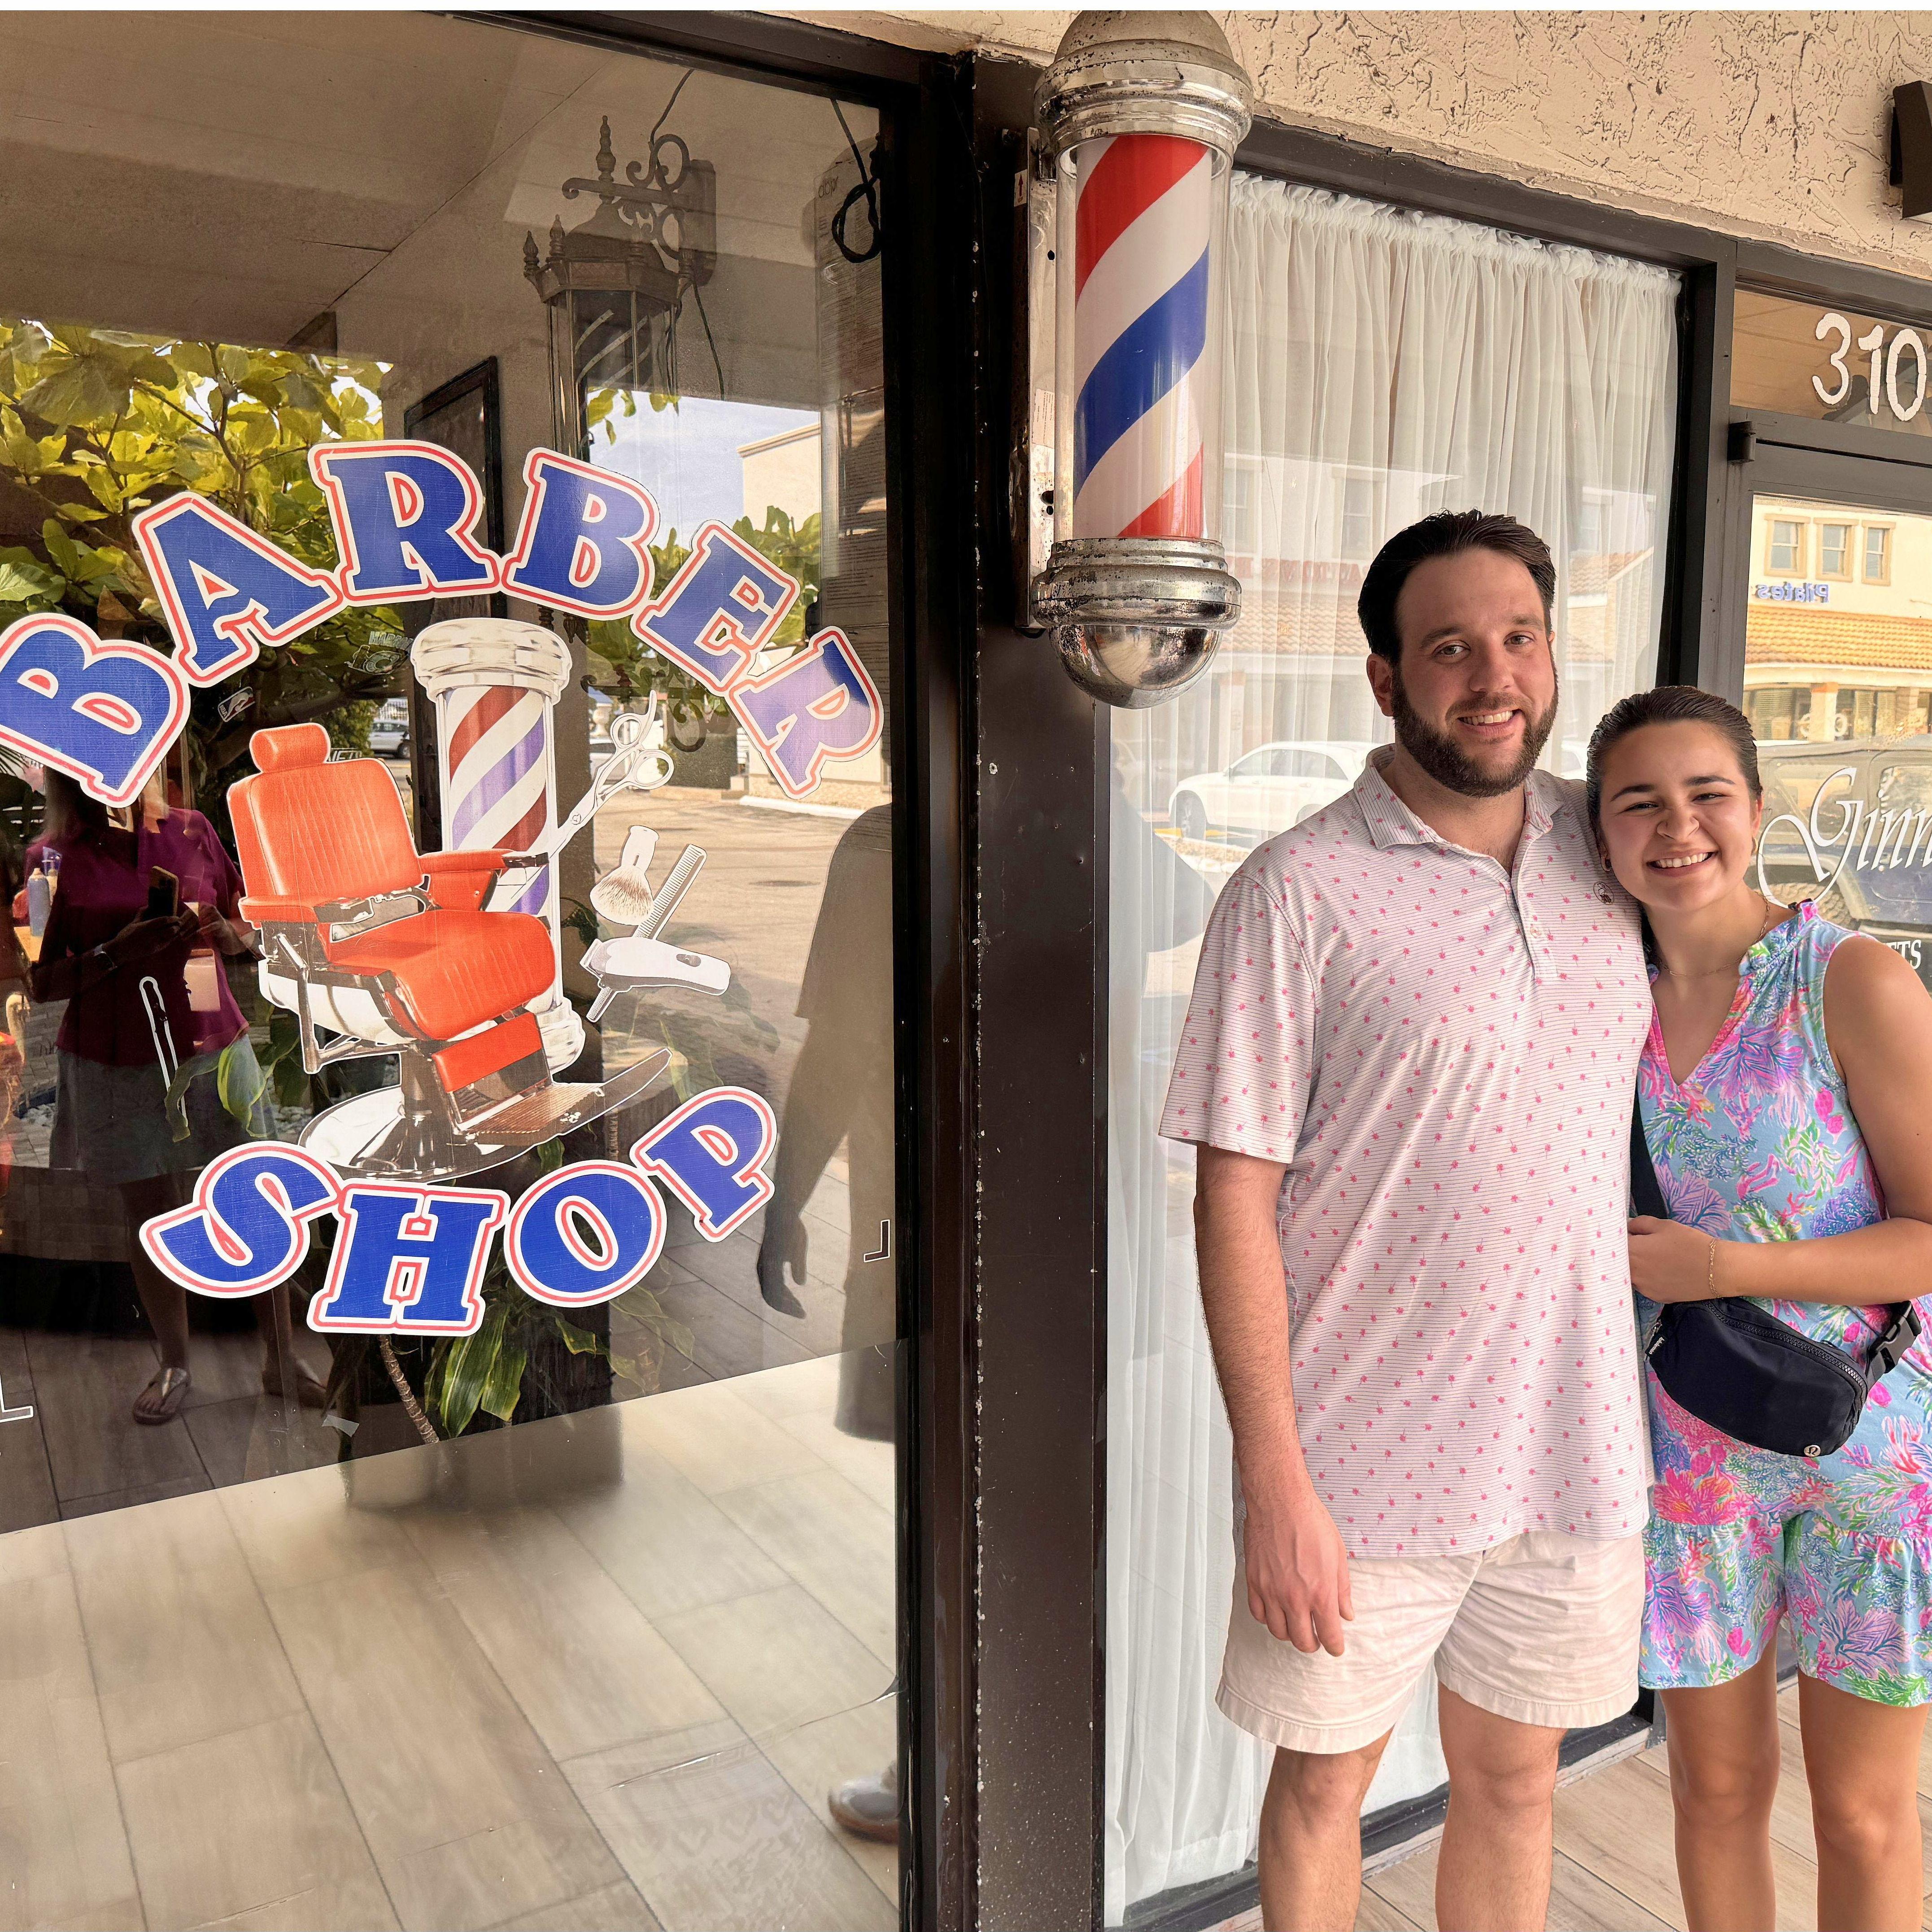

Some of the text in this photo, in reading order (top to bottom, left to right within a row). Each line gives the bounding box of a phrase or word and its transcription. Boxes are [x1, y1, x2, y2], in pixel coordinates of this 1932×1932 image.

[1812, 313, 1927, 422] 310
[0, 440, 885, 809] BARBER
[140, 1086, 777, 1335] SHOP
